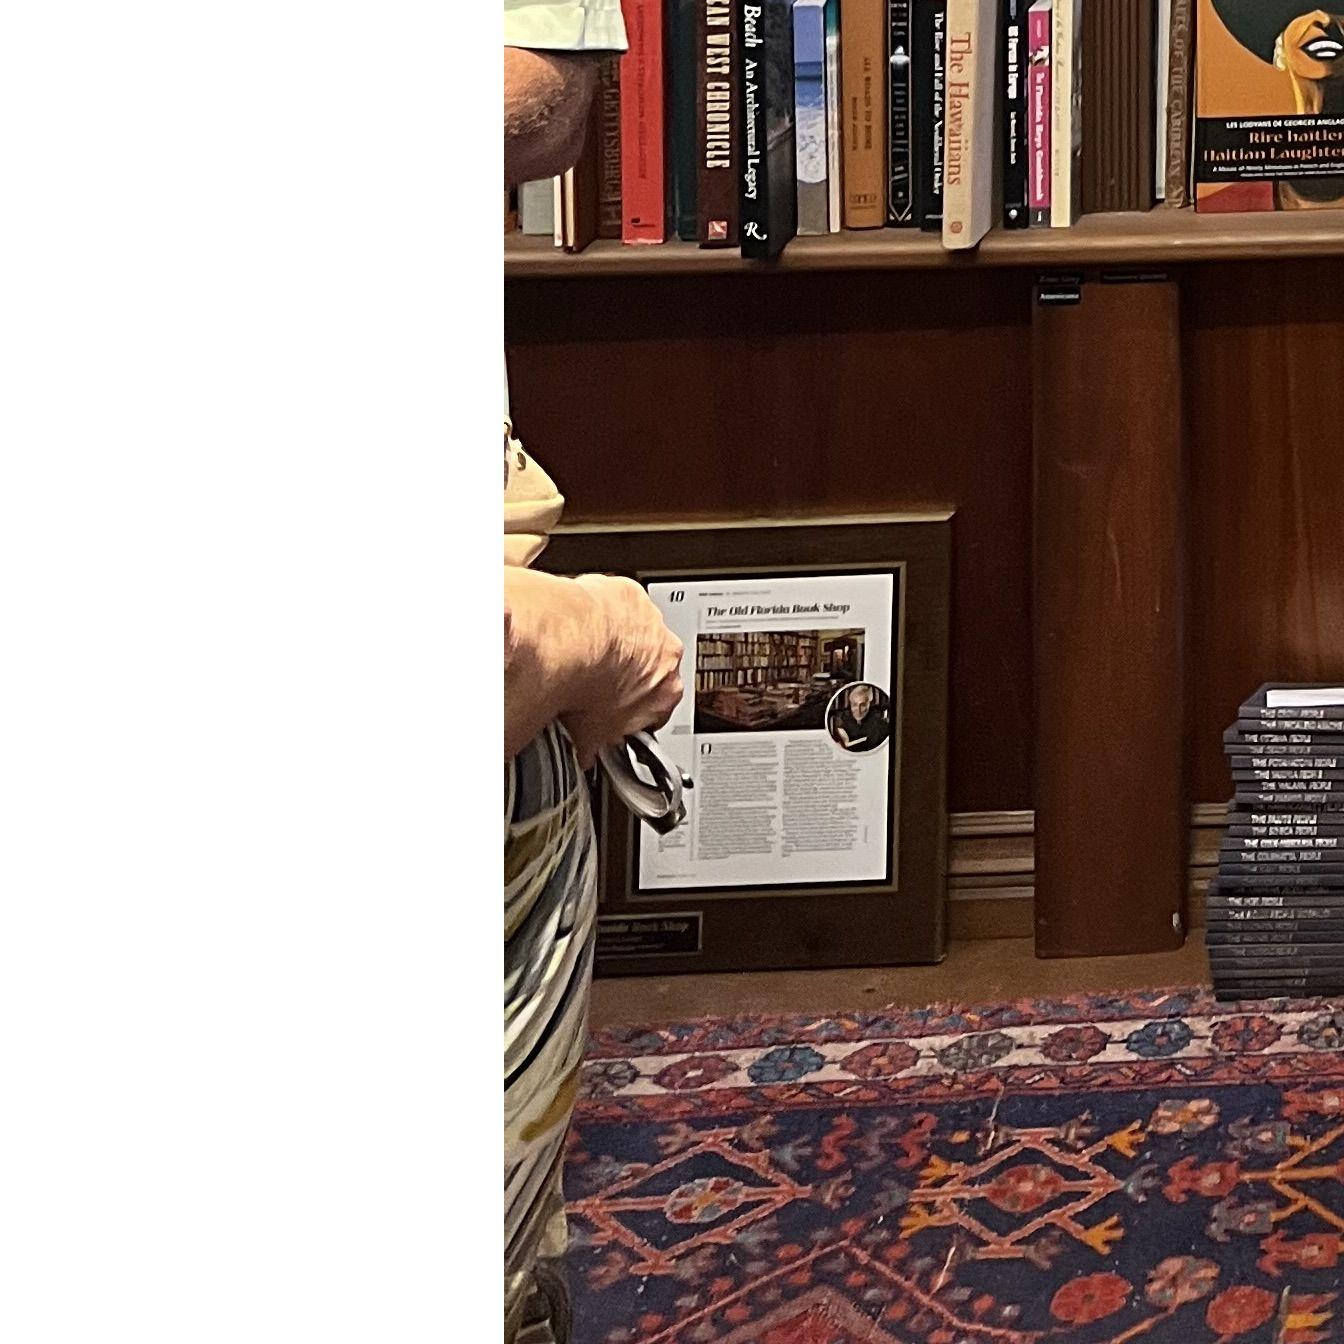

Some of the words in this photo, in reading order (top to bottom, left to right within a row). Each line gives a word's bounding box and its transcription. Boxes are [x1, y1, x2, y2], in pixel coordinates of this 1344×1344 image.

[742, 3, 761, 48] Beach
[706, 32, 730, 74] WEST
[745, 58, 758, 79] An
[947, 32, 972, 77] The
[706, 81, 730, 169] CHRONICLE
[743, 82, 760, 157] Architectural
[946, 82, 969, 186] Hawaiians
[1249, 131, 1284, 144] Rire
[1203, 147, 1266, 162] Haitian
[743, 159, 760, 200] Legacy
[707, 605, 727, 617] The
[729, 604, 749, 616] Old
[750, 603, 790, 615] Florida
[792, 603, 820, 614] Book
[823, 602, 850, 613] Shop
